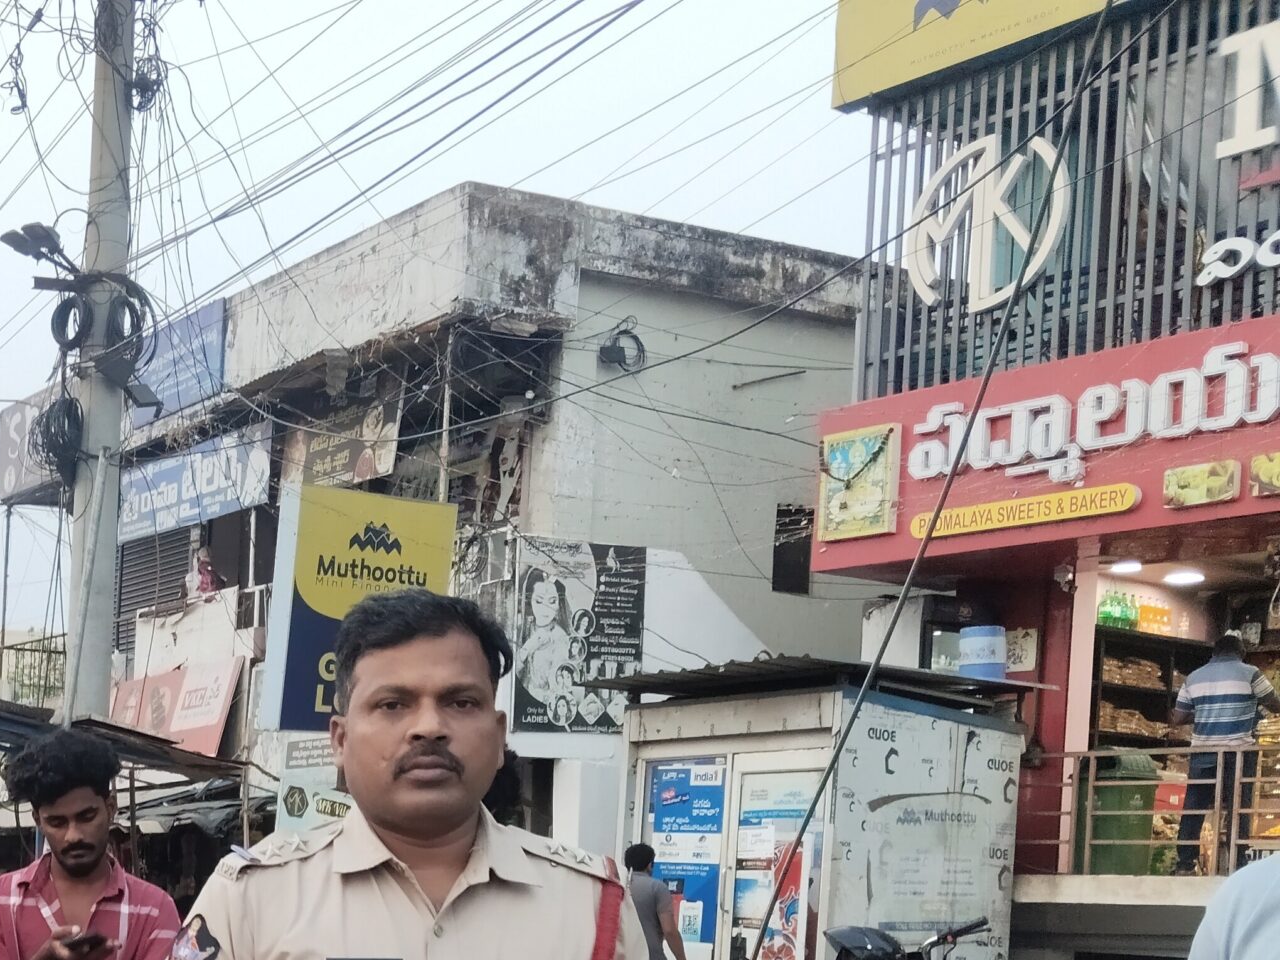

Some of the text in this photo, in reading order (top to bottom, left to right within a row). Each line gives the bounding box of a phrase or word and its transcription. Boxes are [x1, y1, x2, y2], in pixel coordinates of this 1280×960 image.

[997, 500, 1053, 523] SWEETS
[1055, 501, 1065, 514] &
[1069, 488, 1130, 513] BAKERY
[317, 554, 428, 588] Muthoottu
[315, 576, 344, 589] Mini
[526, 706, 539, 715] Only
[522, 714, 549, 724] LADIES
[924, 808, 977, 824] Muthoottu
